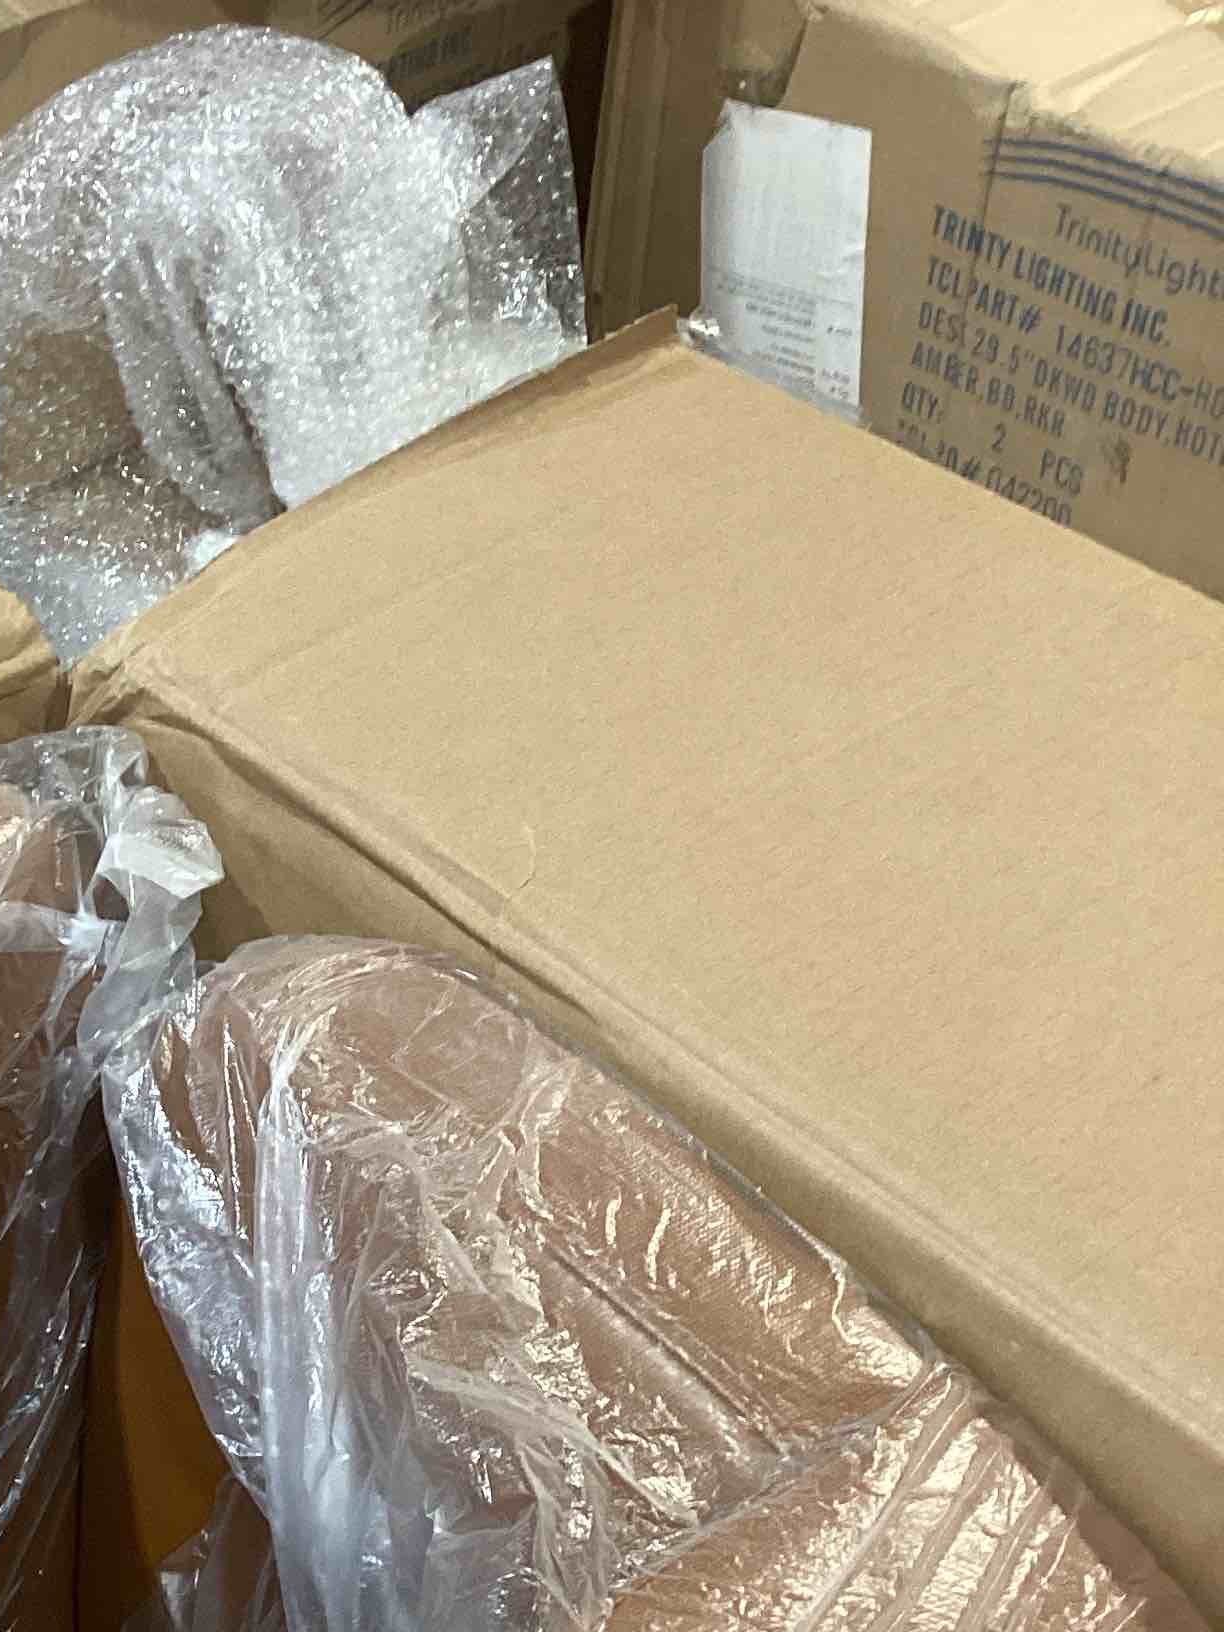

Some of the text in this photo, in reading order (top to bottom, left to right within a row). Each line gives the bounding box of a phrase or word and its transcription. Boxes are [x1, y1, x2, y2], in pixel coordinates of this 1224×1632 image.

[1013, 246, 1117, 325] LIGHTING
[1055, 202, 1224, 300] TrinityLight
[927, 256, 963, 299] TCL
[967, 275, 1041, 334] PART#
[991, 422, 1007, 451] 2
[1039, 449, 1084, 496] PCS
[1103, 388, 1224, 465] BODY,HOT
